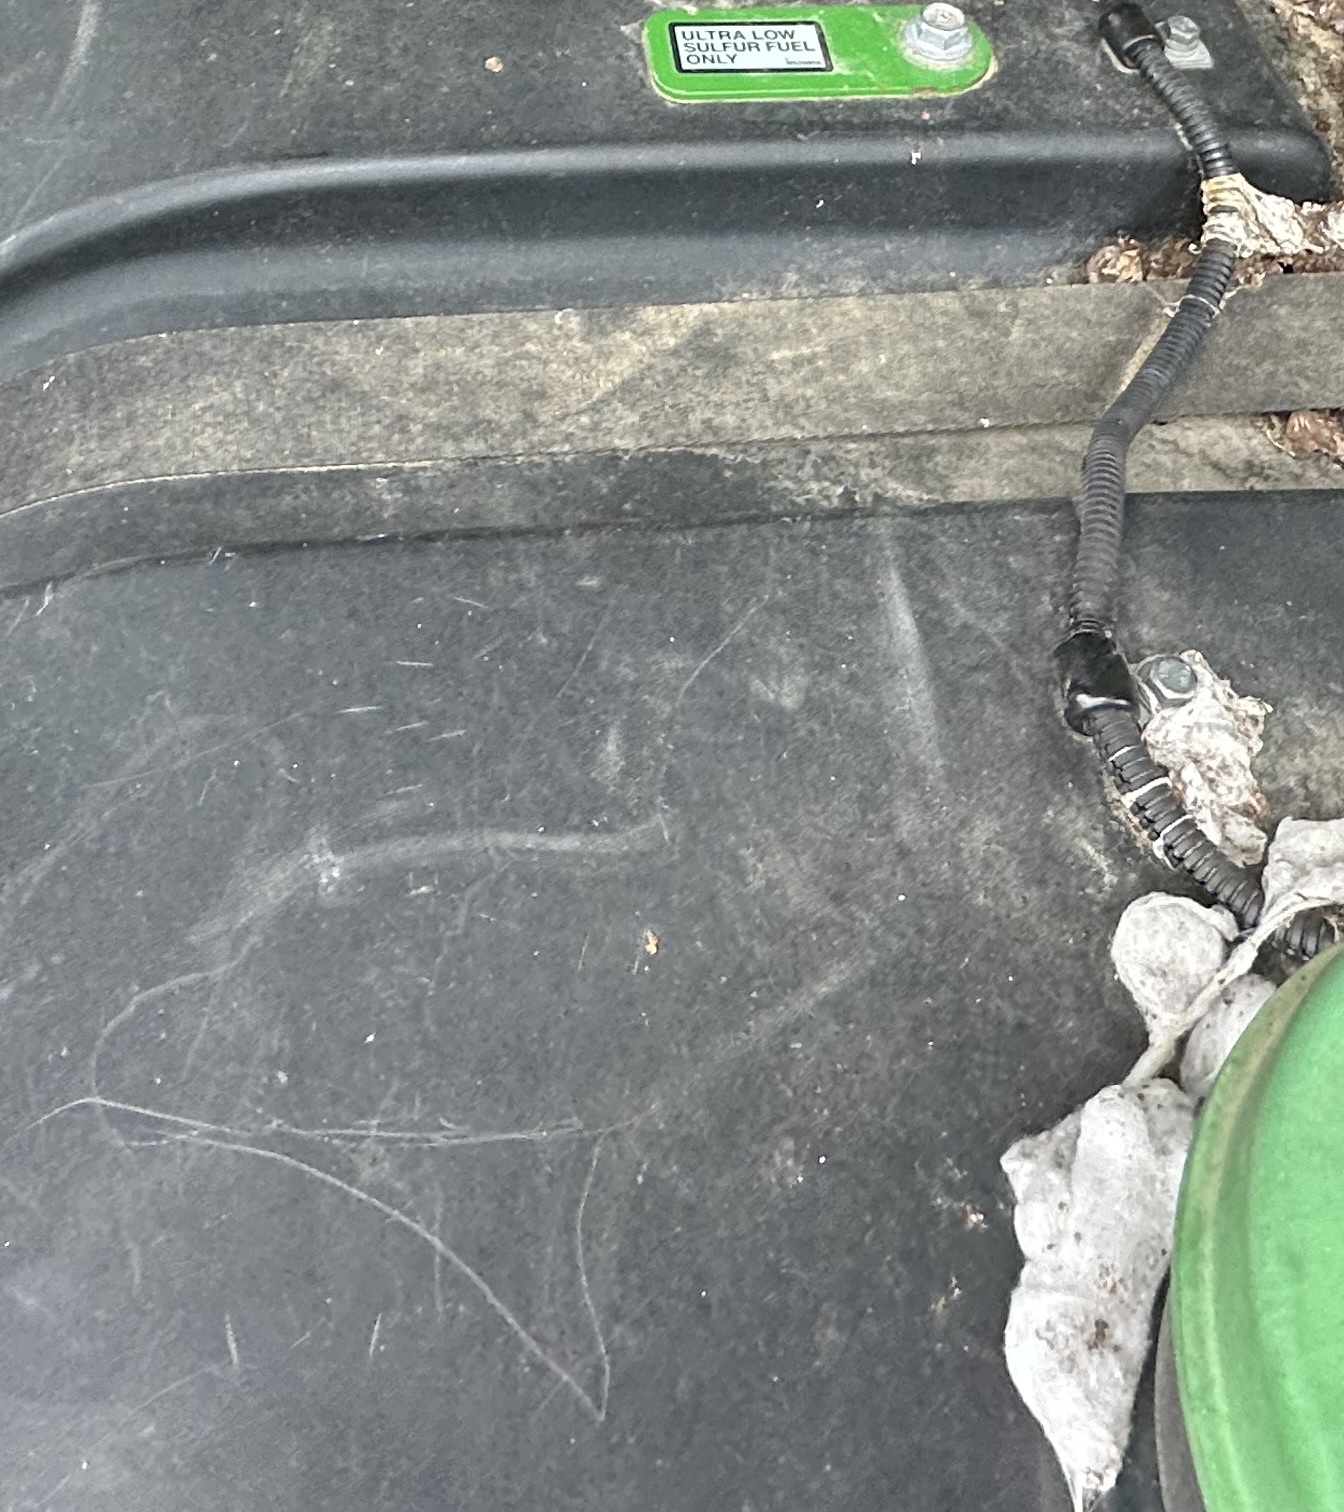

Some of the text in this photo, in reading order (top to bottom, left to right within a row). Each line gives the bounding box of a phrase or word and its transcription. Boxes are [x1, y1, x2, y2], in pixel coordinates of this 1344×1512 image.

[681, 29, 795, 41] ULTRA LOW
[683, 41, 816, 53] SULFUR FUEL
[686, 53, 738, 65] ONLY
